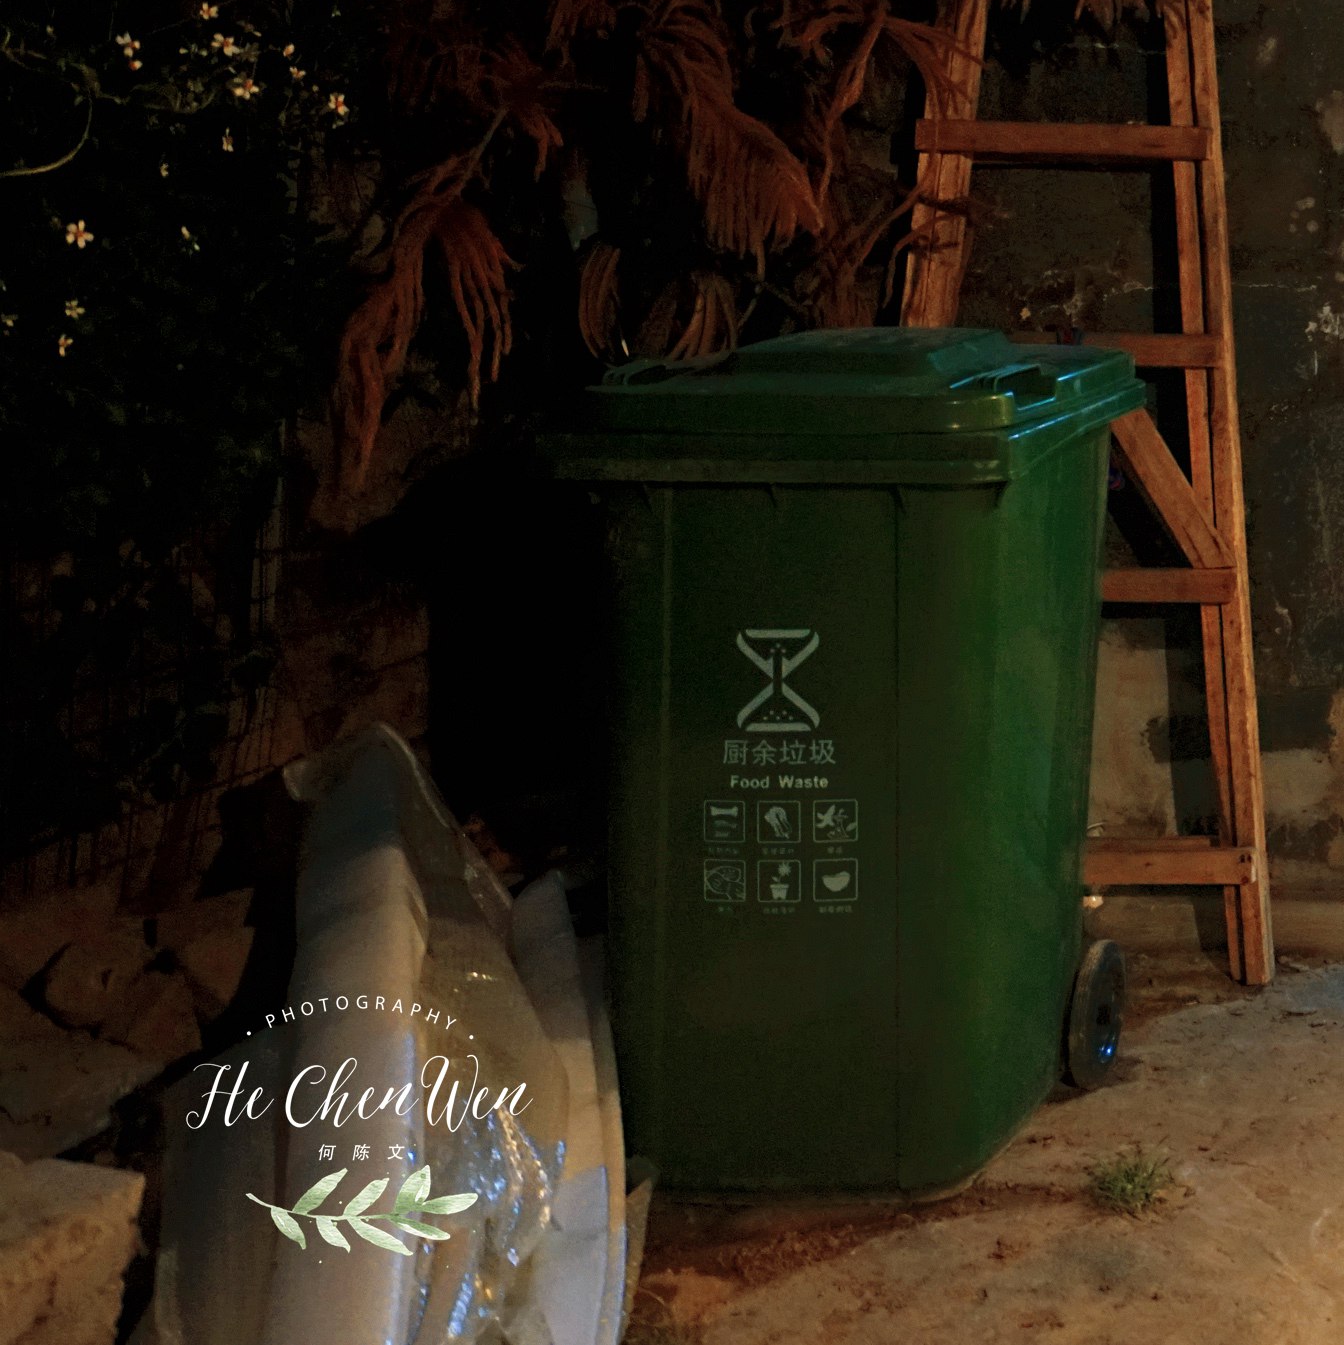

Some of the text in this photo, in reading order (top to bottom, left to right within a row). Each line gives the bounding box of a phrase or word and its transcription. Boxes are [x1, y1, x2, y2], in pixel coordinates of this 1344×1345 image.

[722, 739, 837, 766] 厨余垃圾
[730, 774, 829, 789] Food Waste
